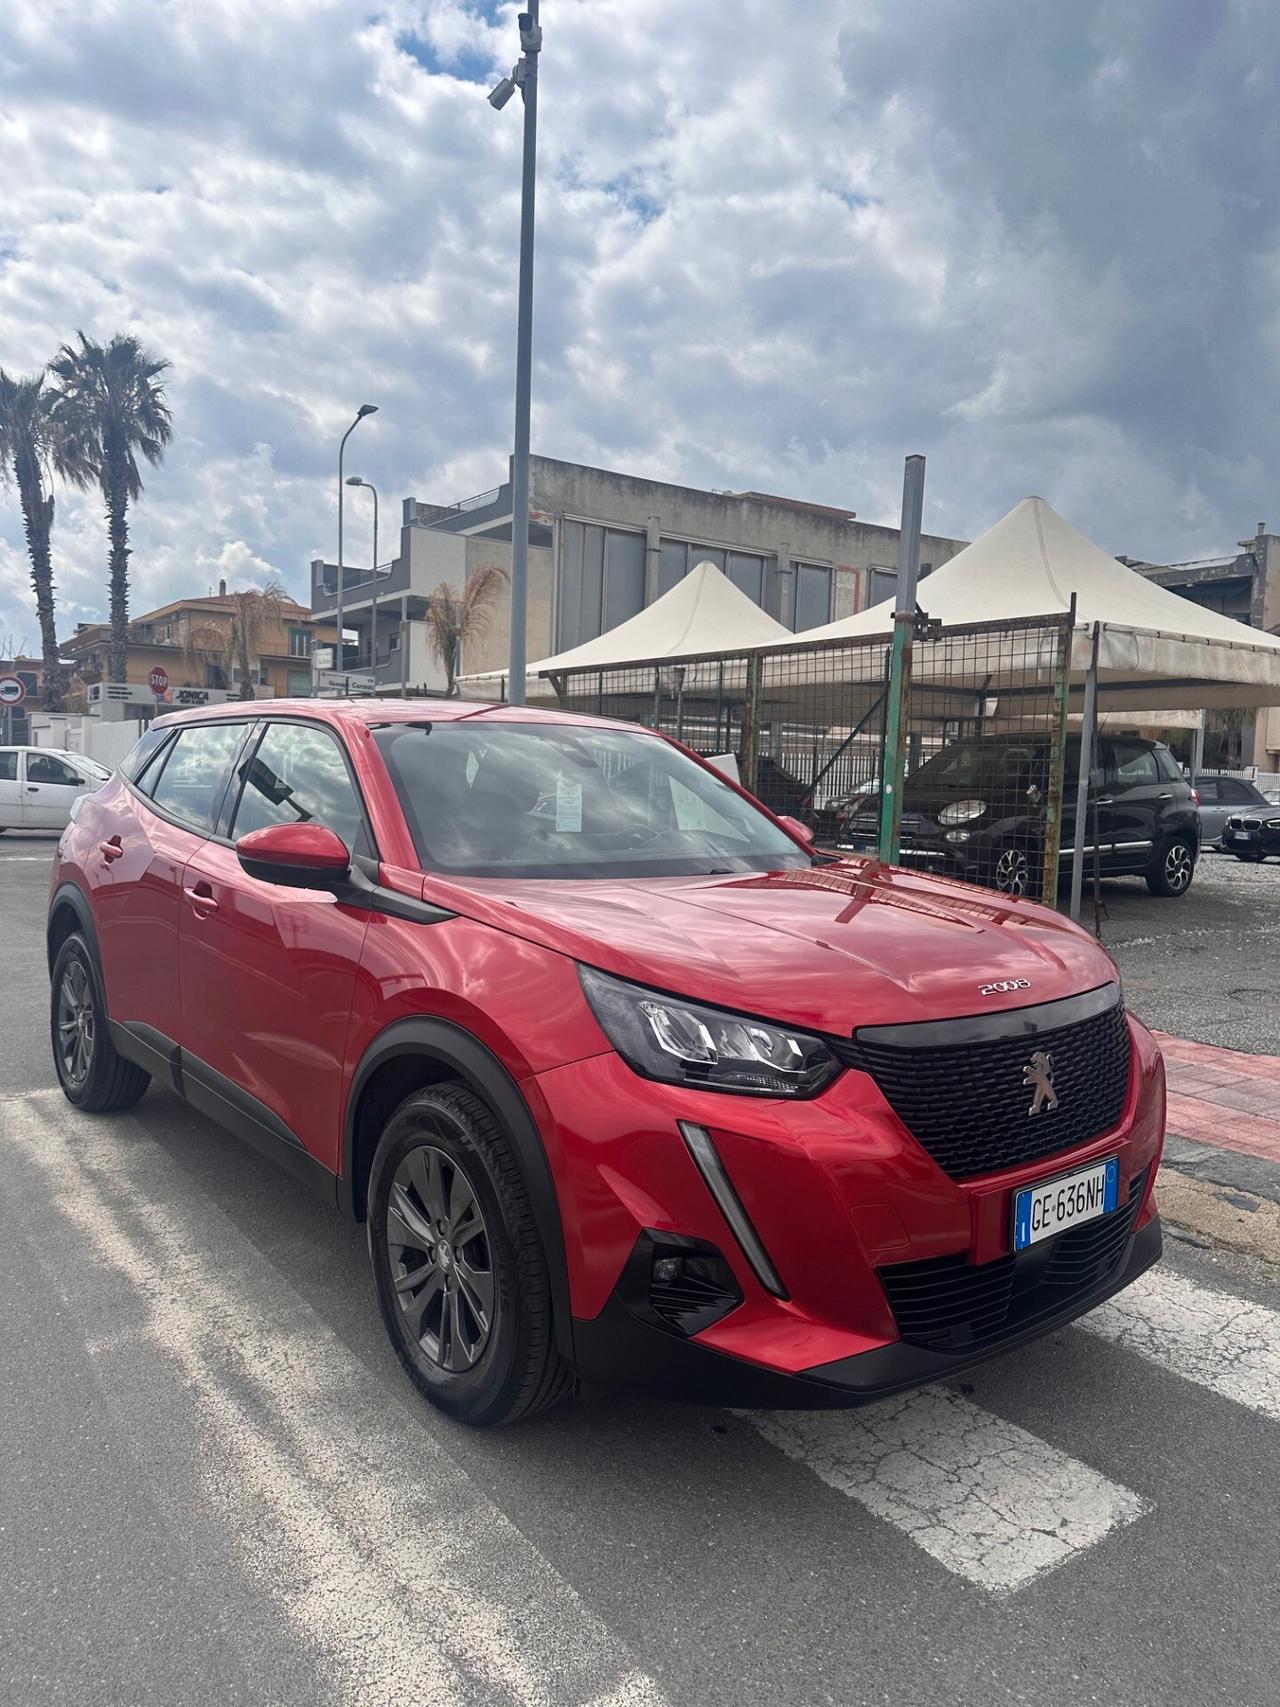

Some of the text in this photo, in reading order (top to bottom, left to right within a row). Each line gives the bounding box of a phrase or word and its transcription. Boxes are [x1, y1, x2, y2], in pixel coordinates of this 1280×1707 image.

[150, 673, 168, 687] STOP
[176, 690, 209, 701] JONICA
[978, 979, 1031, 996] 2008
